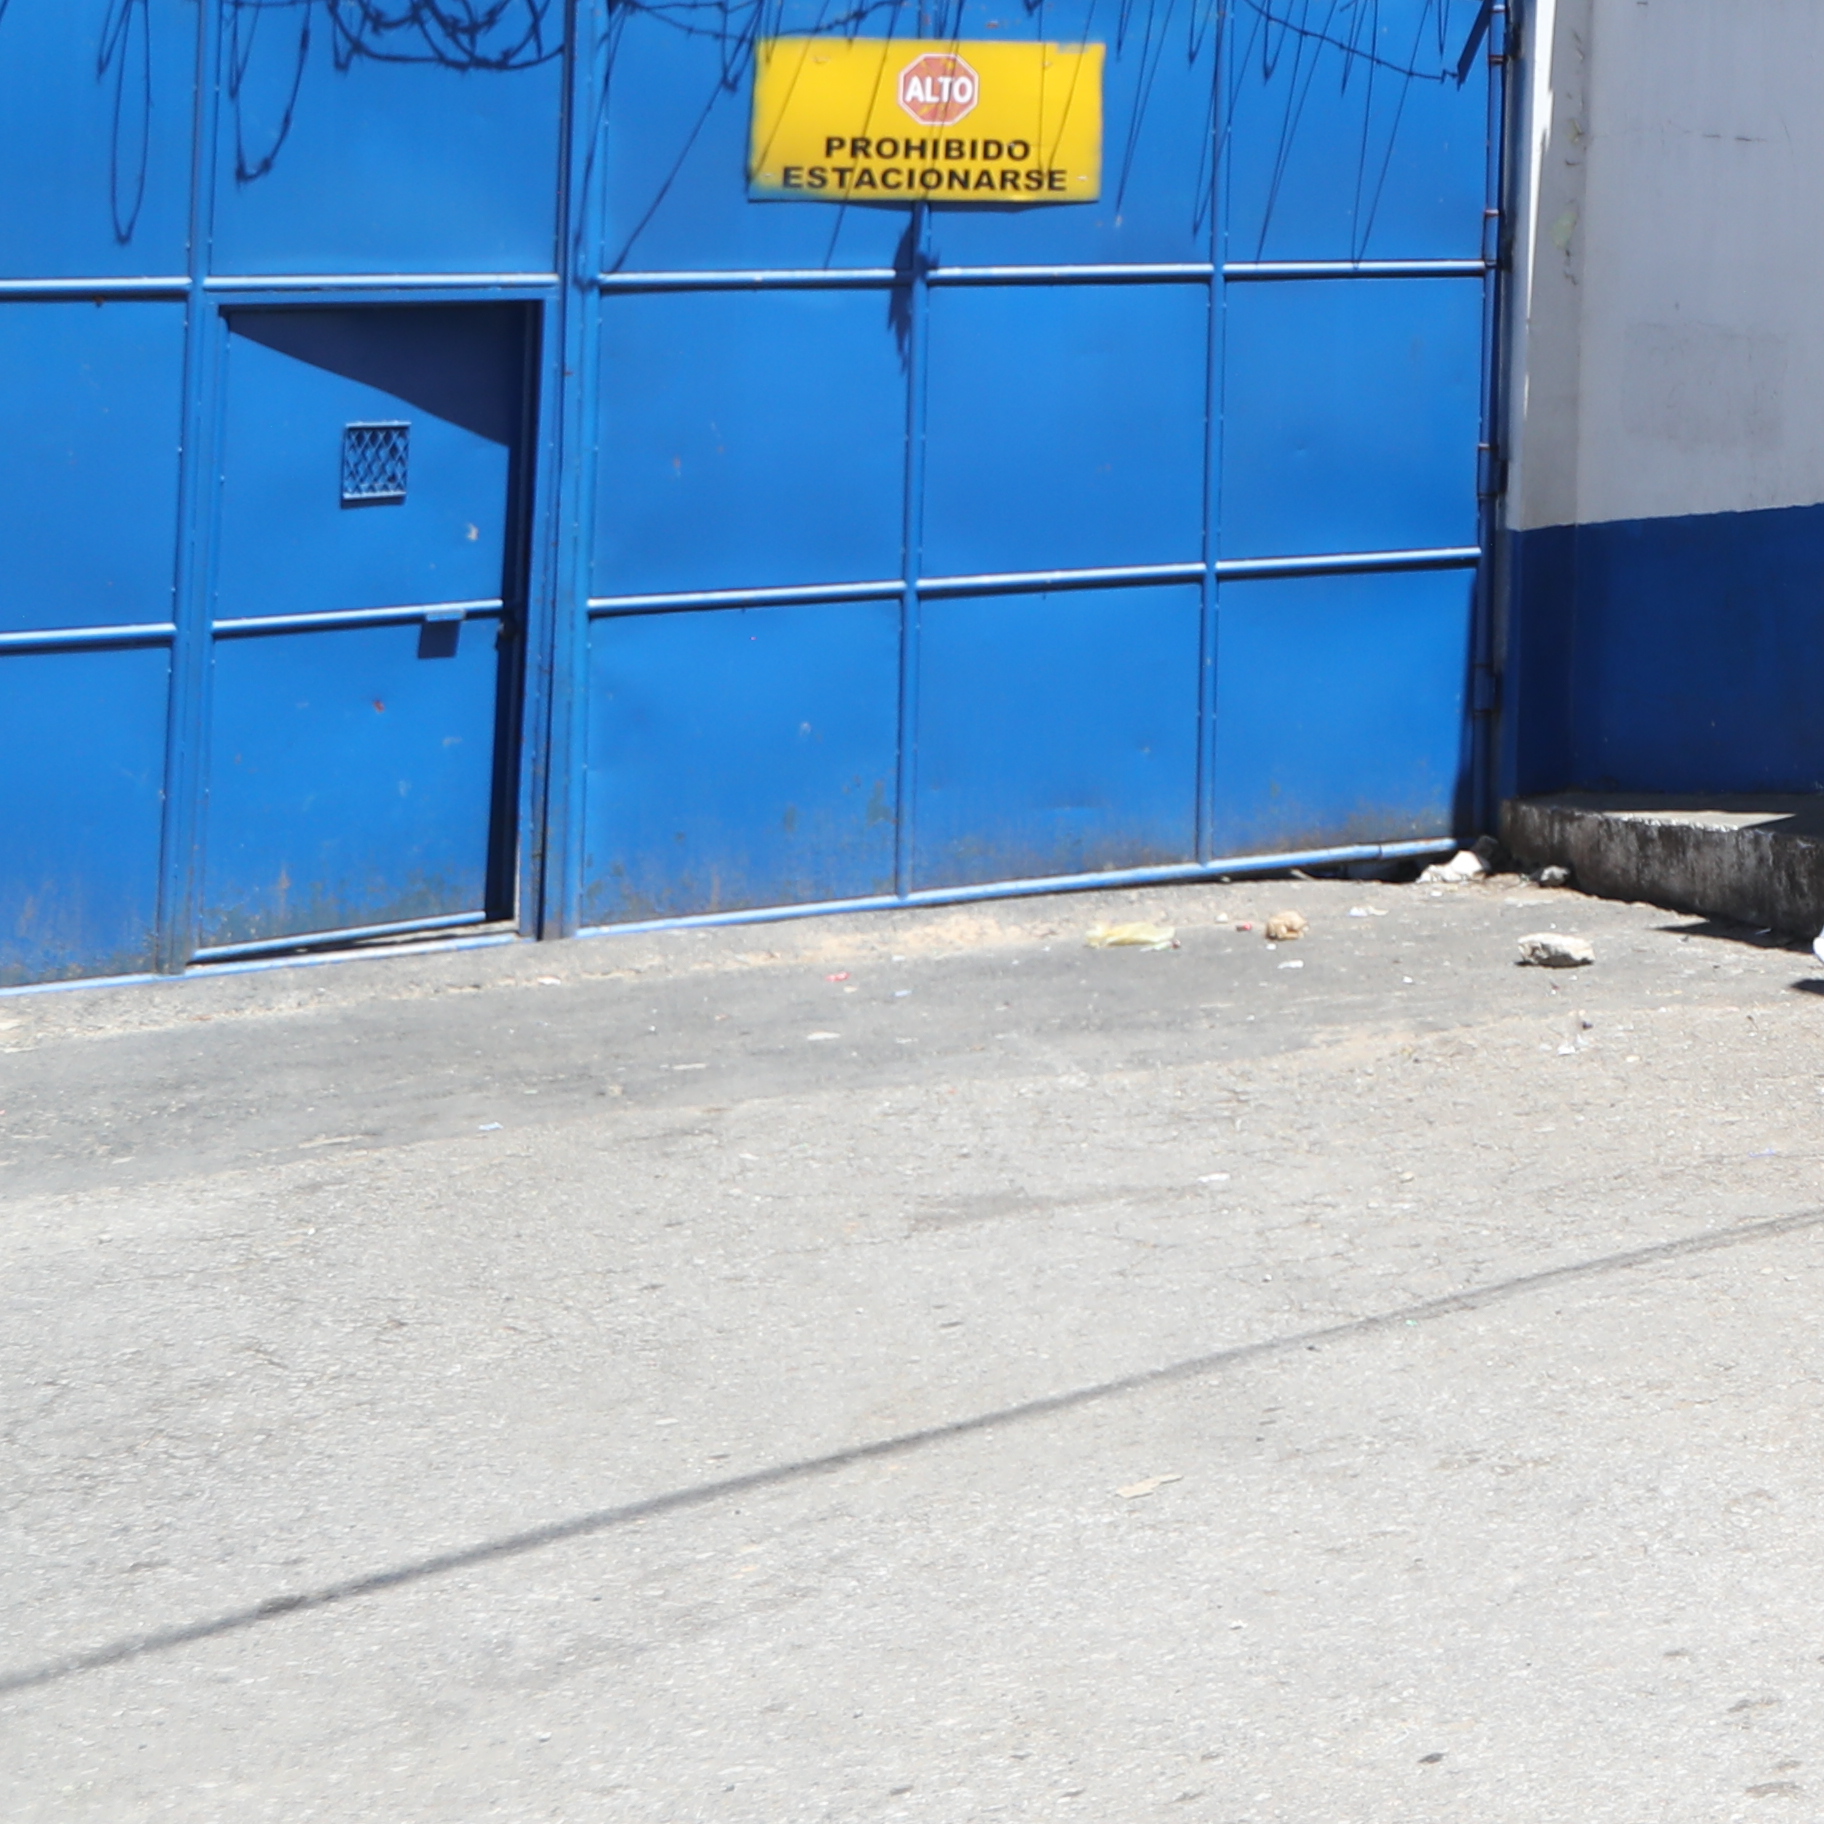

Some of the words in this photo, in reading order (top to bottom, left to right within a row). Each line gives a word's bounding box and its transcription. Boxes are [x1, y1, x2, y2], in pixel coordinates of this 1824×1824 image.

[904, 75, 974, 104] ALTO
[825, 136, 1031, 161] PROHIBIDO
[782, 166, 1068, 192] ESTACIONARSE
